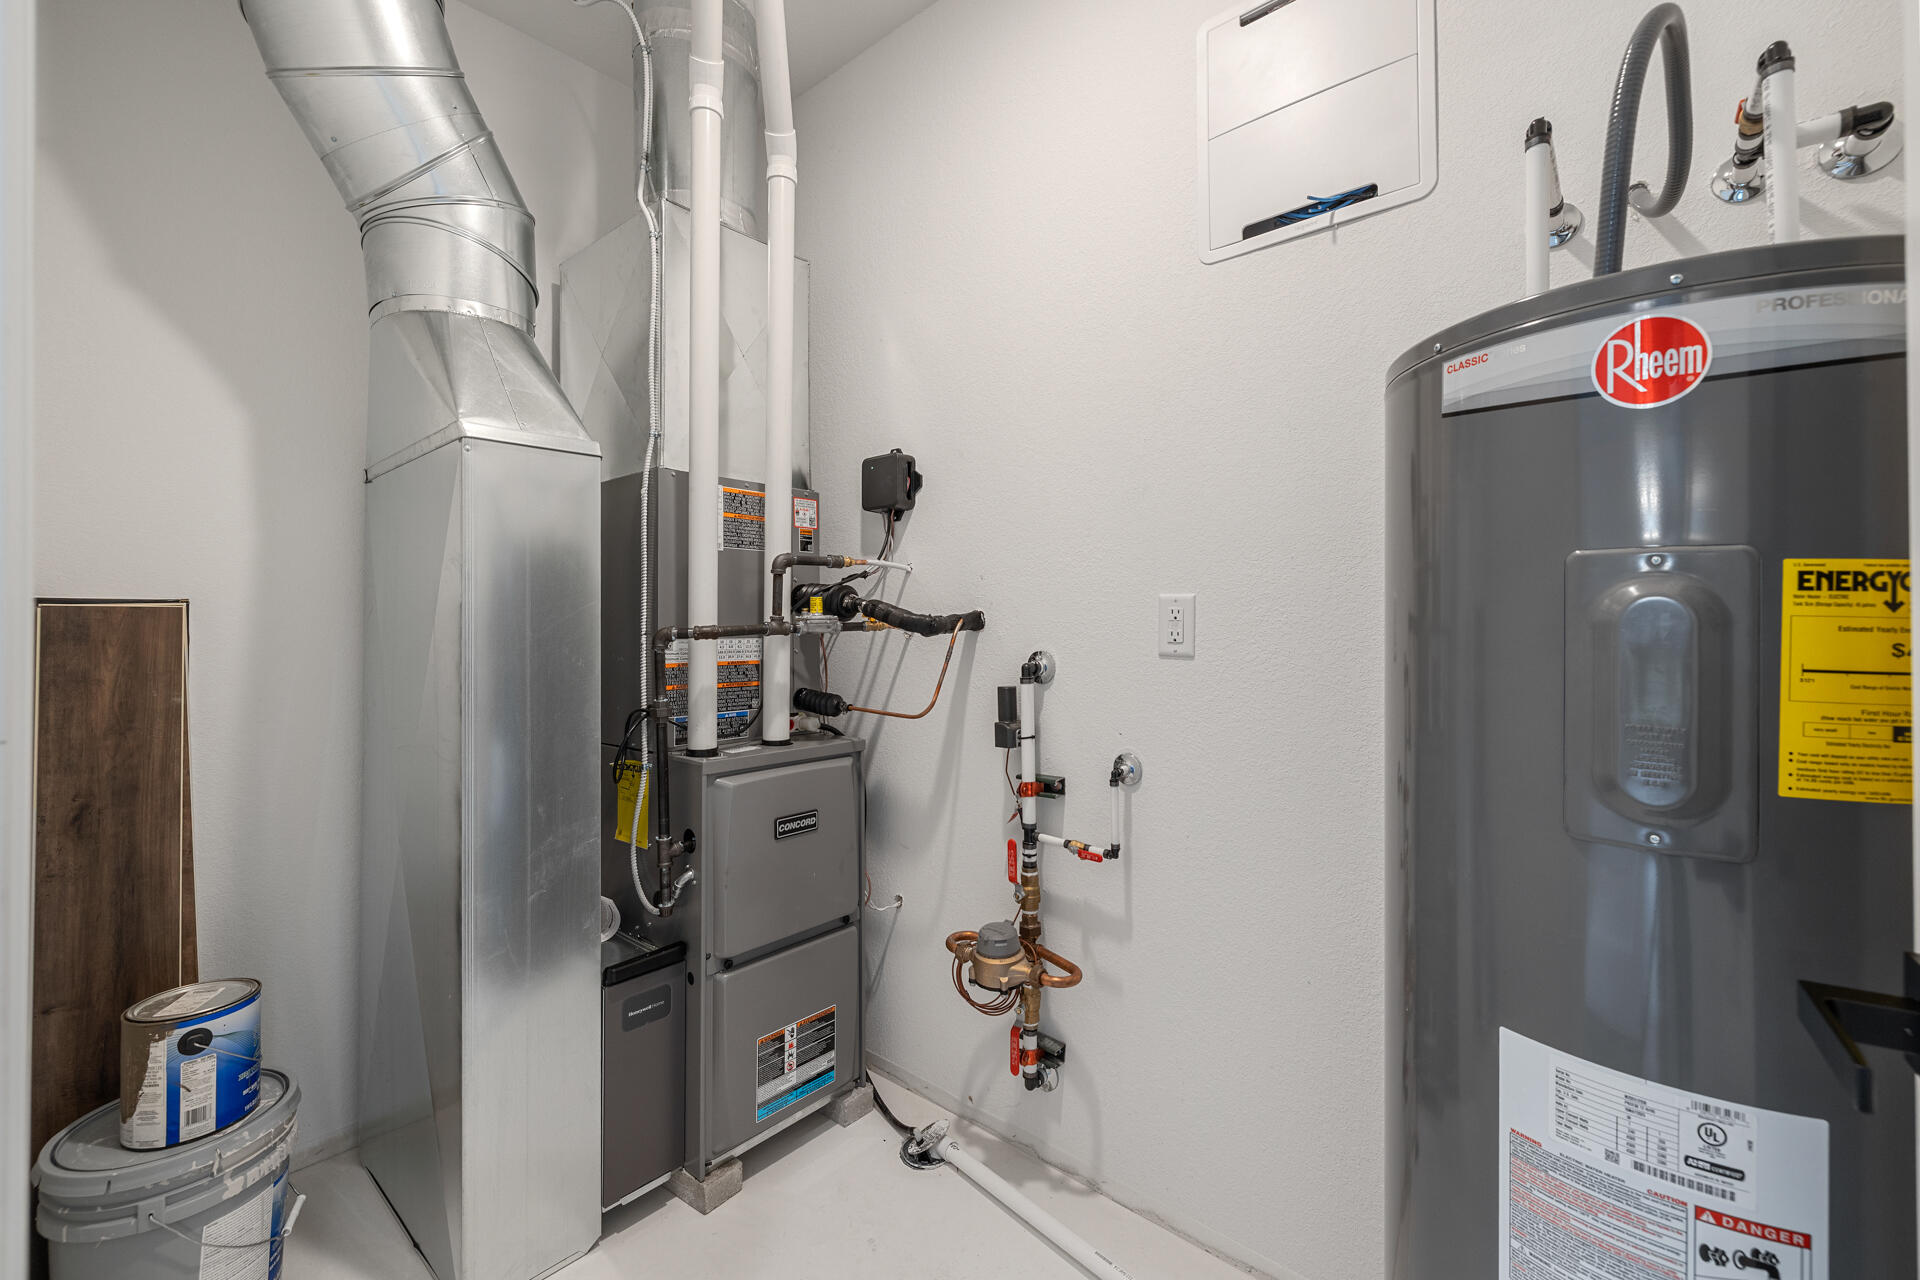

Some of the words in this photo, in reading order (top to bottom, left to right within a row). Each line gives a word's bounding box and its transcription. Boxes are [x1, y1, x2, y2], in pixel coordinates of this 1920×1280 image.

[1447, 353, 1489, 374] CLASSIC
[1607, 321, 1703, 395] Rheem
[779, 817, 816, 832] CONCORD
[1510, 1128, 1542, 1148] WARNING
[1647, 1189, 1688, 1207] CAUTION
[1721, 1216, 1805, 1246] DANGER
